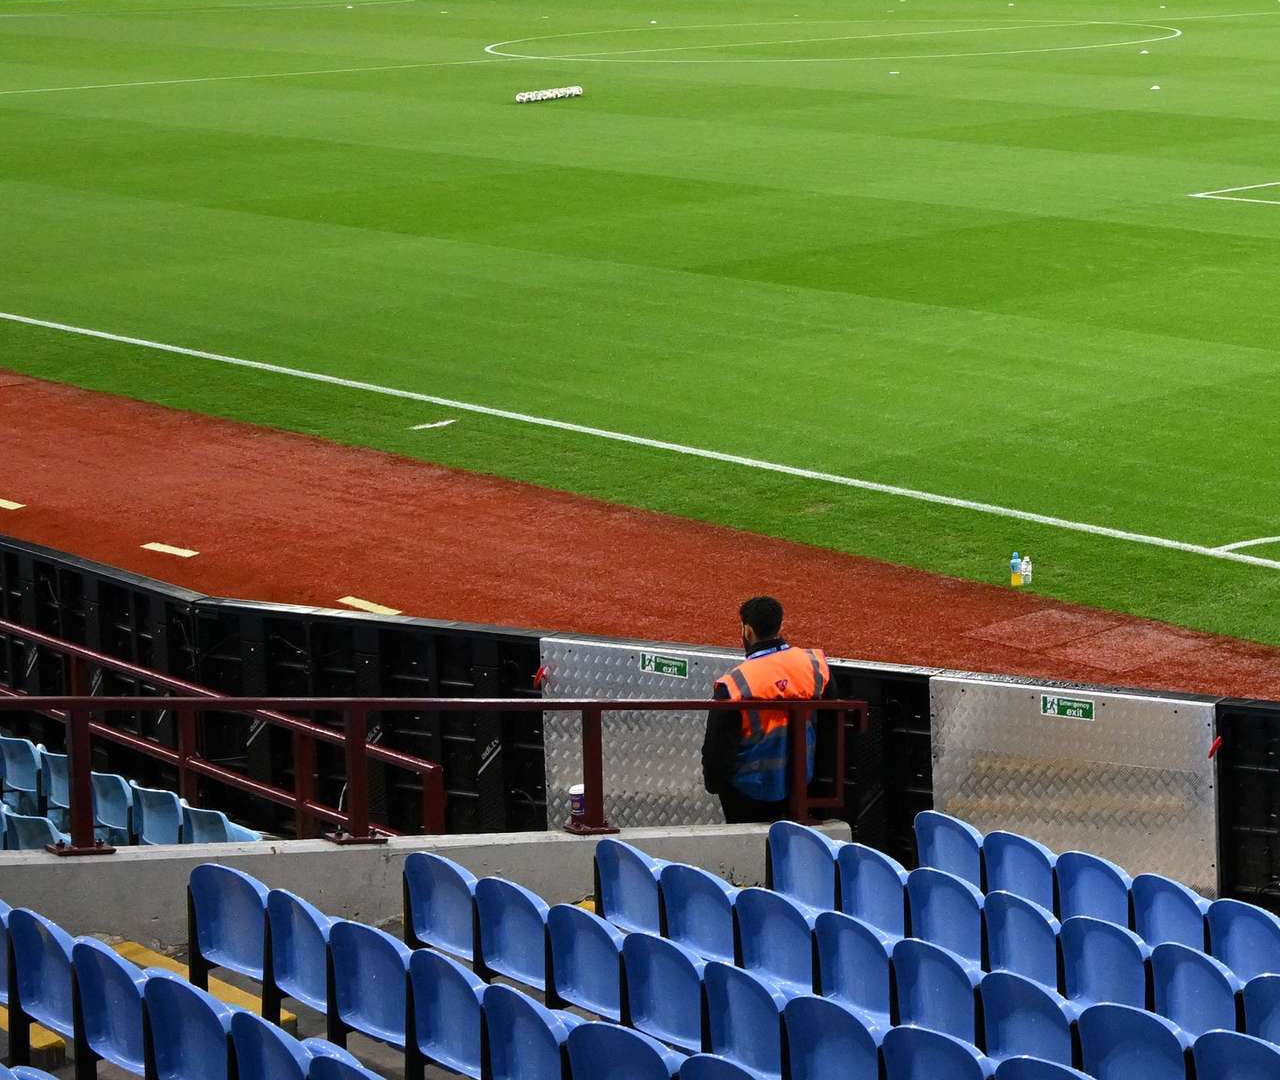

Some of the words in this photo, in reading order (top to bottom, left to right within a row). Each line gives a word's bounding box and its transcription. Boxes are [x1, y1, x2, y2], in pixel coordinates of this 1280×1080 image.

[662, 664, 678, 675] exit
[1059, 699, 1090, 711] Emergency
[1066, 706, 1083, 718] exit
